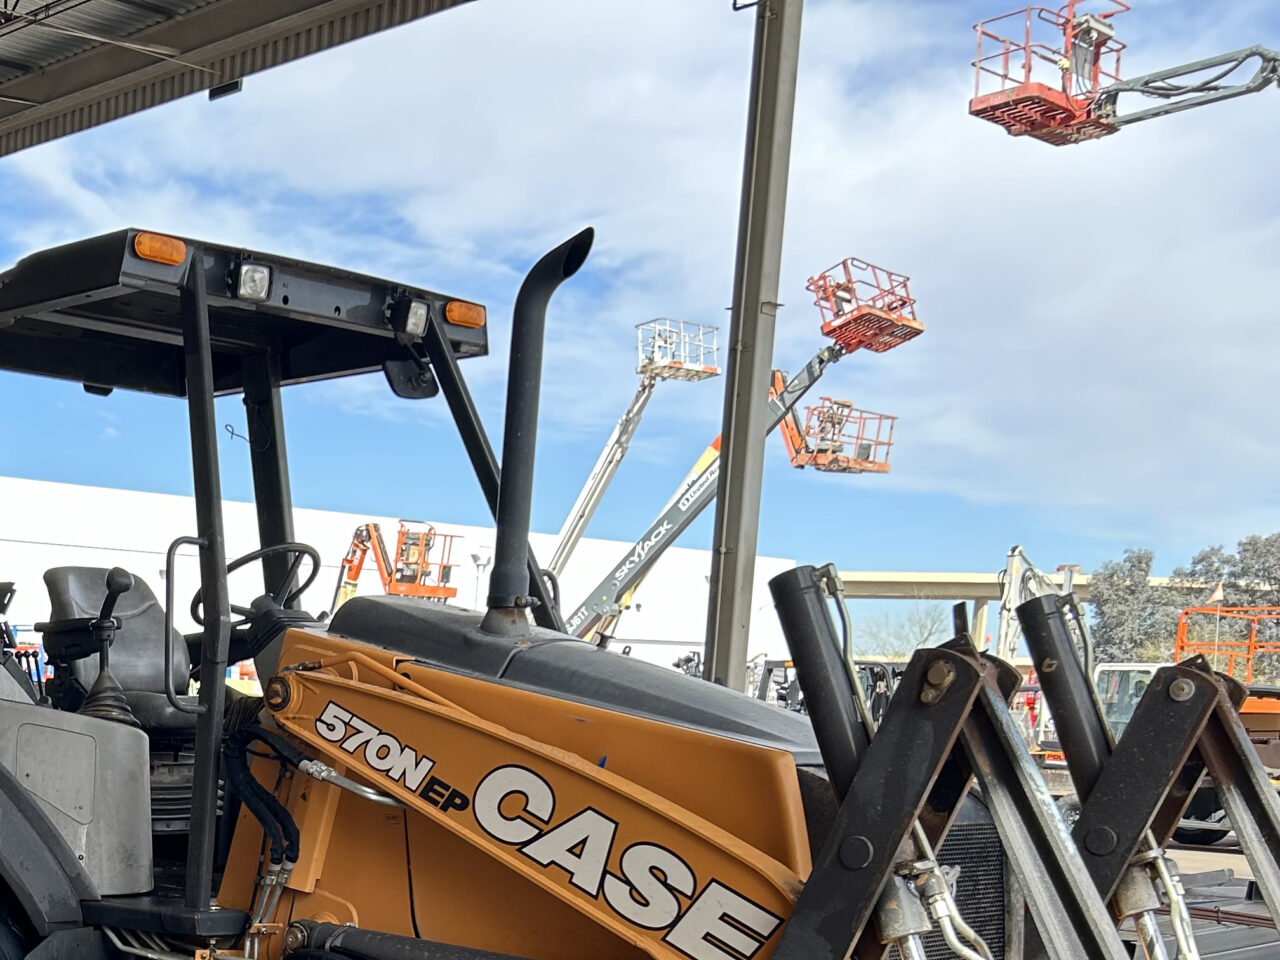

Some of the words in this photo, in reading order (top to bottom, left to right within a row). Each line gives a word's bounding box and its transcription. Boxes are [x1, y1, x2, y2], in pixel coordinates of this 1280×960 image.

[688, 477, 710, 499] United
[615, 519, 673, 581] SKYJACK
[314, 700, 437, 794] 570N
[418, 775, 470, 813] EP
